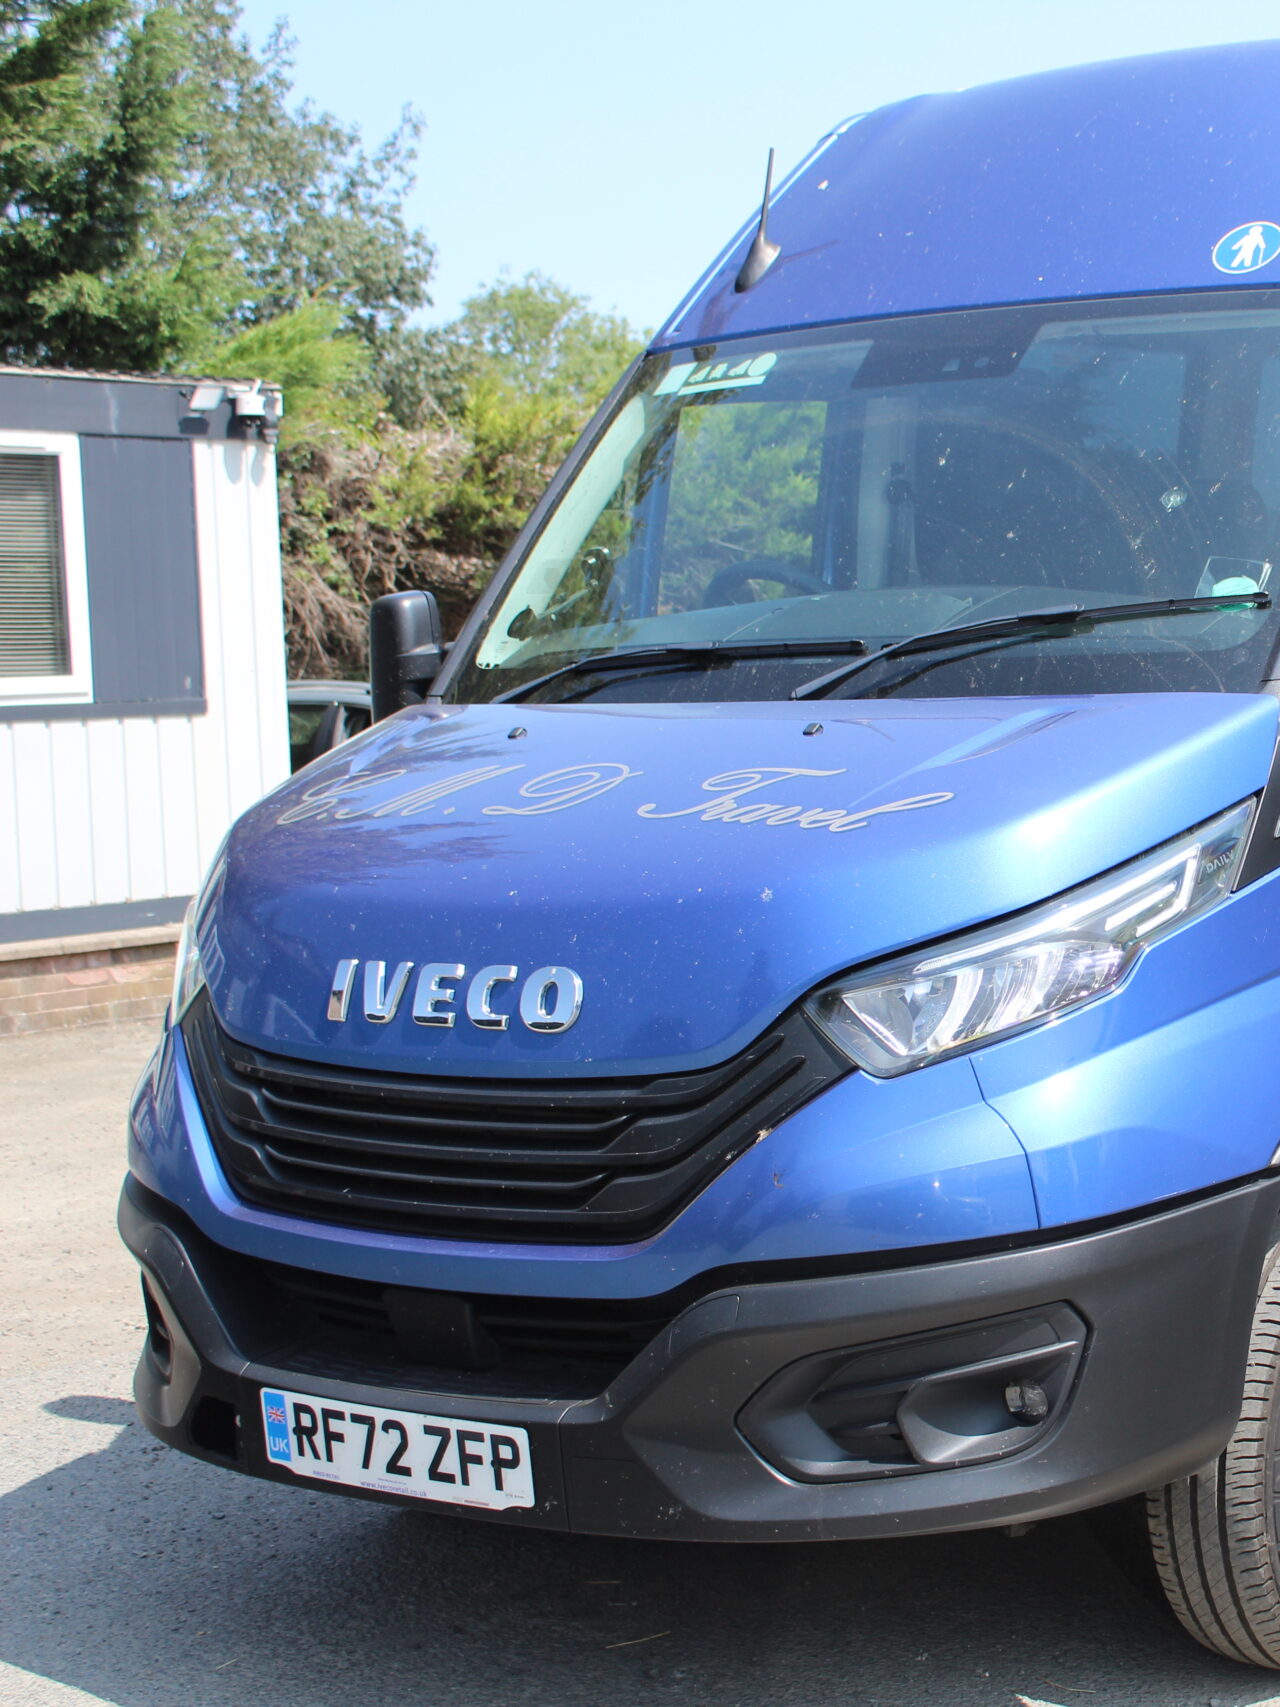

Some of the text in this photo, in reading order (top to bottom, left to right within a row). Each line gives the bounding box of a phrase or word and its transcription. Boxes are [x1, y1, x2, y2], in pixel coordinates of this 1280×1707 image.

[636, 767, 955, 833] Travel
[1205, 850, 1234, 874] DAILY
[326, 958, 584, 1034] IVECO
[270, 1435, 291, 1455] UK
[292, 1401, 522, 1492] RF72 ZFP
